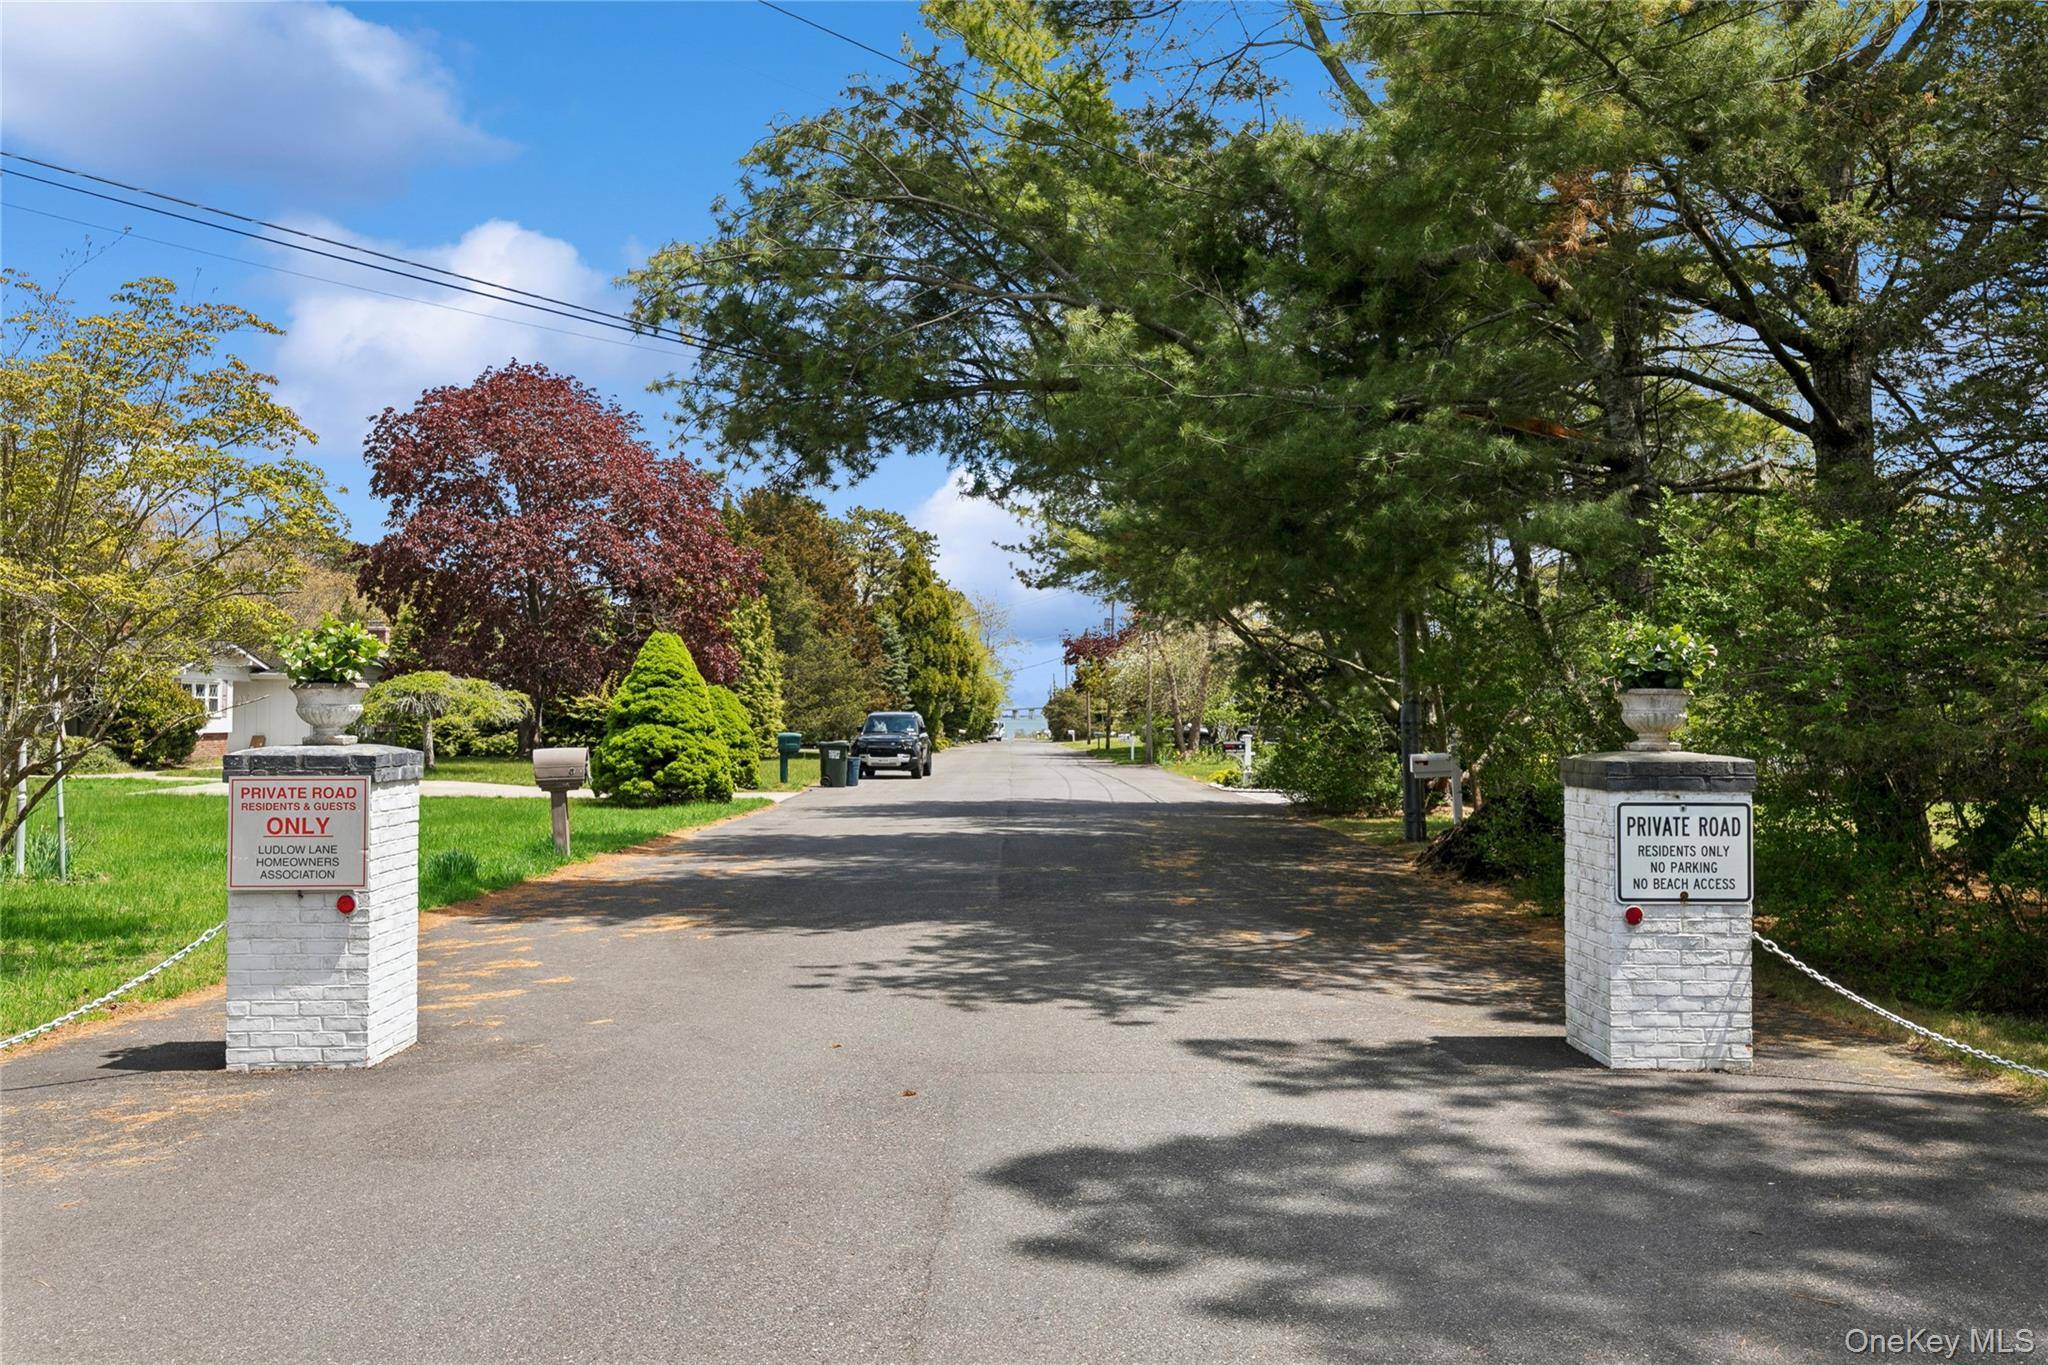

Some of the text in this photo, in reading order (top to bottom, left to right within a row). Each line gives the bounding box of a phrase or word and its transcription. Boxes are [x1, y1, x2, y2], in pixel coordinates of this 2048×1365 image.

[241, 787, 357, 799] PRIVATE ROAD
[241, 802, 357, 811] RESIDENTS & GUESTS
[266, 816, 330, 835] ONLY
[1627, 816, 1741, 837] PRIVATE ROAD
[258, 844, 338, 855] LUDLOW LANE
[1638, 845, 1730, 857] RESIDENTS ONLY
[256, 857, 340, 867] HOMEOWNERS
[1650, 861, 1718, 874] NO PARKING
[260, 869, 335, 880] ASSOCIATION
[1633, 878, 1736, 890] NO BEACH ACCESS
